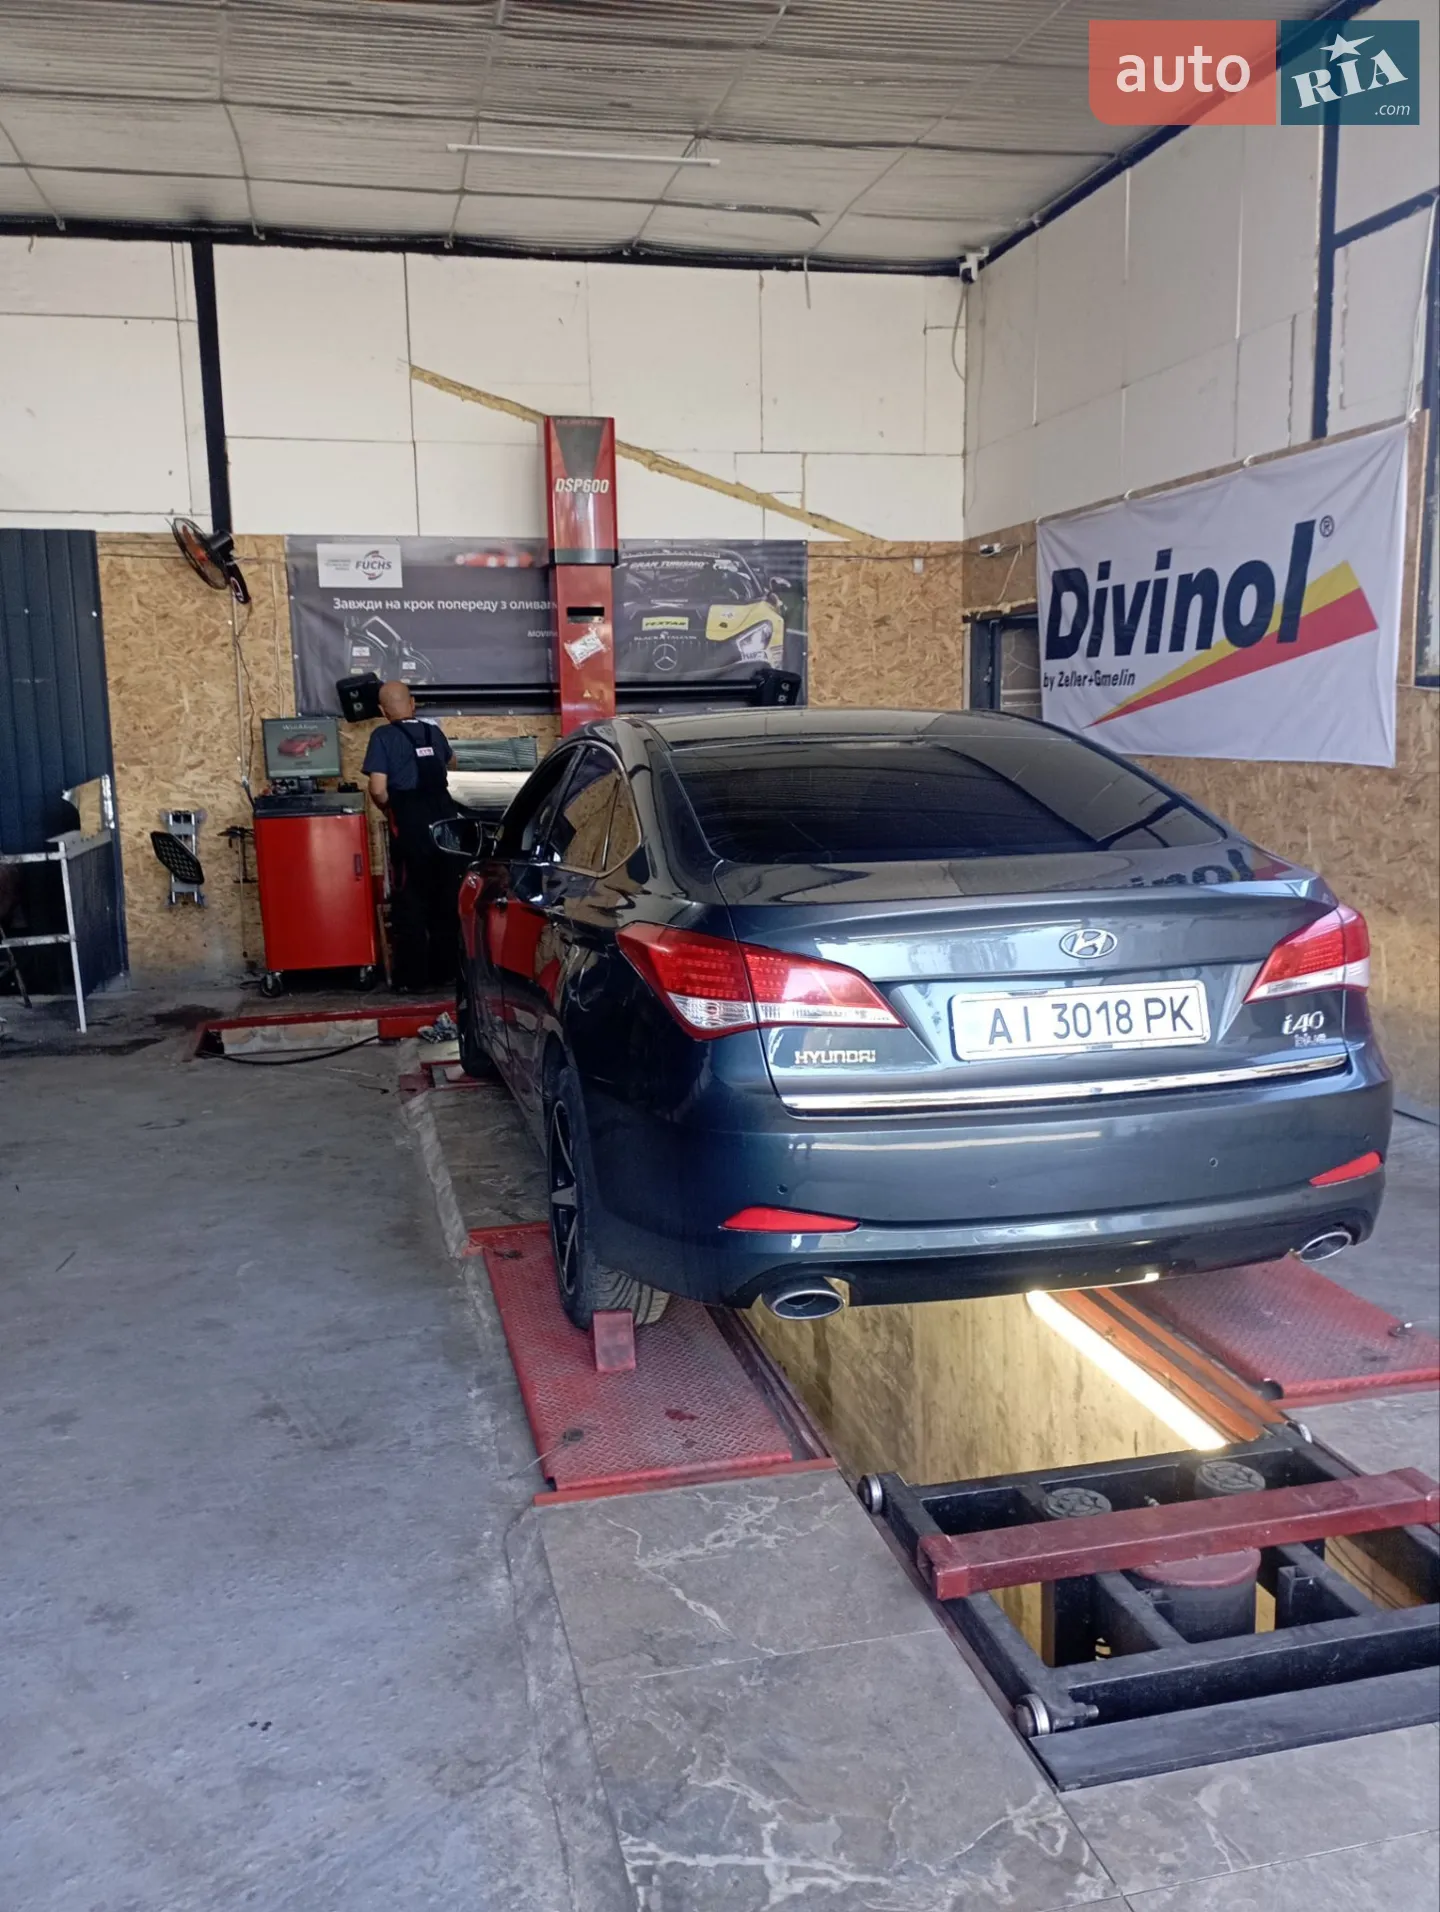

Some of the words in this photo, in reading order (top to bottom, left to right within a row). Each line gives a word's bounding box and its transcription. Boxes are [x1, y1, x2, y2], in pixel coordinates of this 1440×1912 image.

[555, 478, 610, 493] DSP600
[355, 560, 392, 570] FUCHS
[1045, 519, 1316, 661] Divinol
[333, 598, 383, 611] Завжди
[386, 600, 401, 610] на
[404, 600, 434, 612] крок
[438, 600, 498, 612] попереду
[500, 600, 507, 610] з
[1043, 672, 1055, 691] by
[1057, 668, 1136, 688] Zeller+Gmelin
[988, 1006, 1032, 1045] AI
[1051, 999, 1134, 1040] 3018
[1144, 995, 1194, 1034] PK
[1282, 1010, 1324, 1035] i40
[794, 1049, 876, 1065] HYUNDAI
